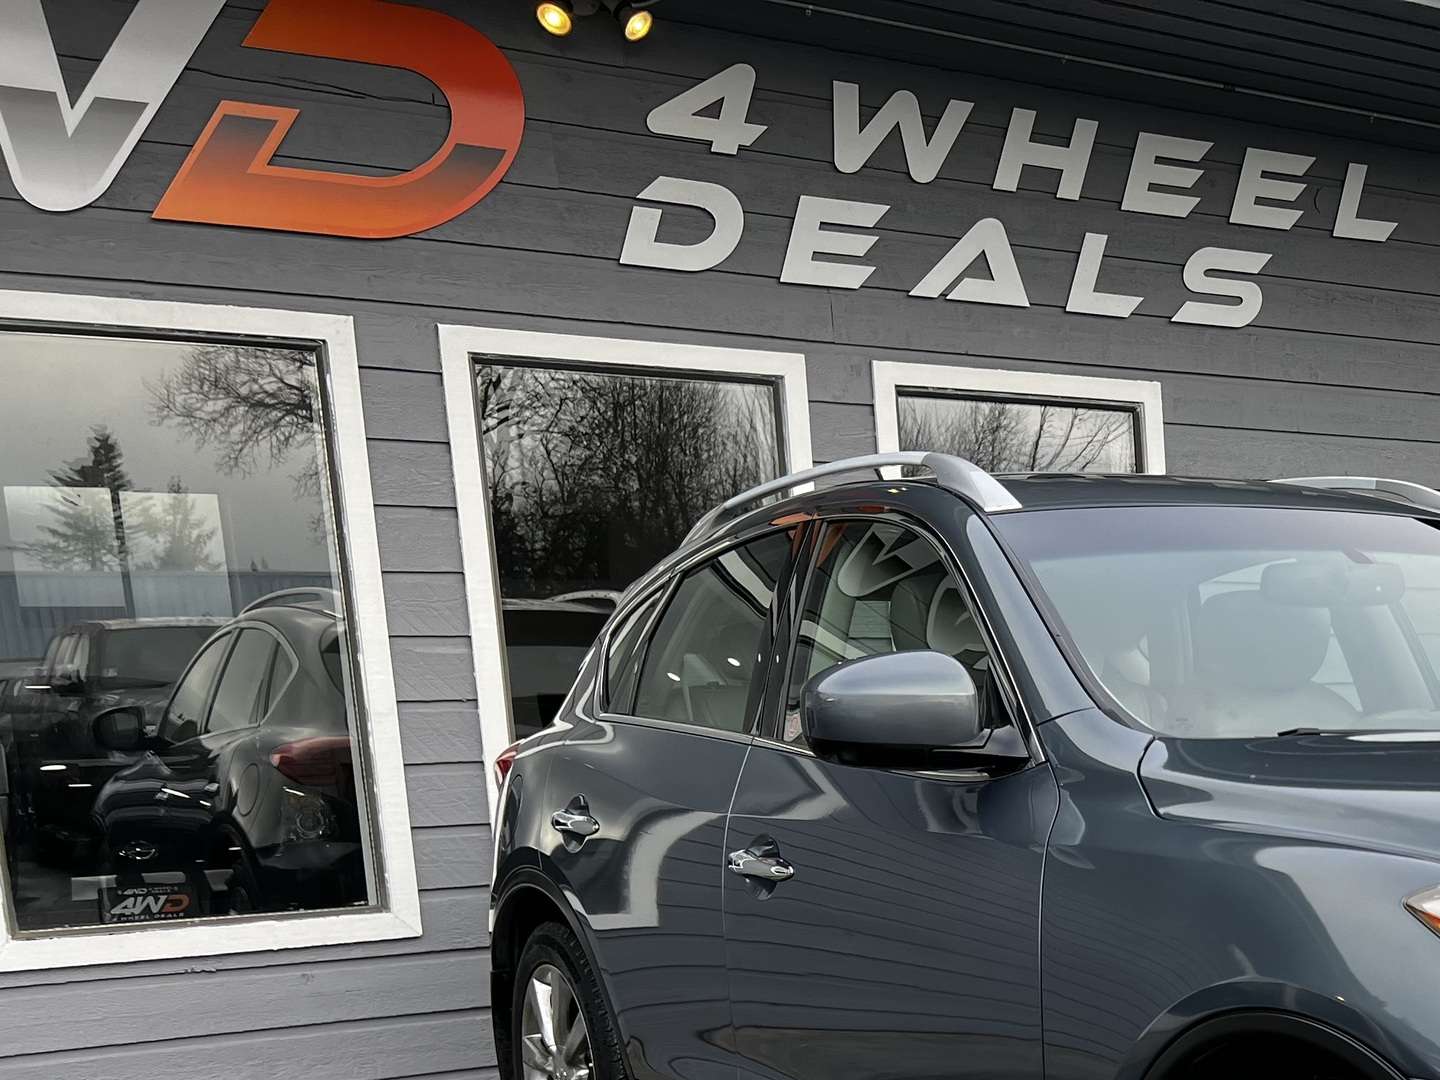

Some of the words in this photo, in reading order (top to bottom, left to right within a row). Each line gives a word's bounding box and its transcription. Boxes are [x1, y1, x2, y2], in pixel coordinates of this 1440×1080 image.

[646, 63, 768, 155] 4
[832, 79, 1398, 242] WHEEL
[618, 176, 1273, 328] DEALS
[110, 895, 190, 915] 4WD
